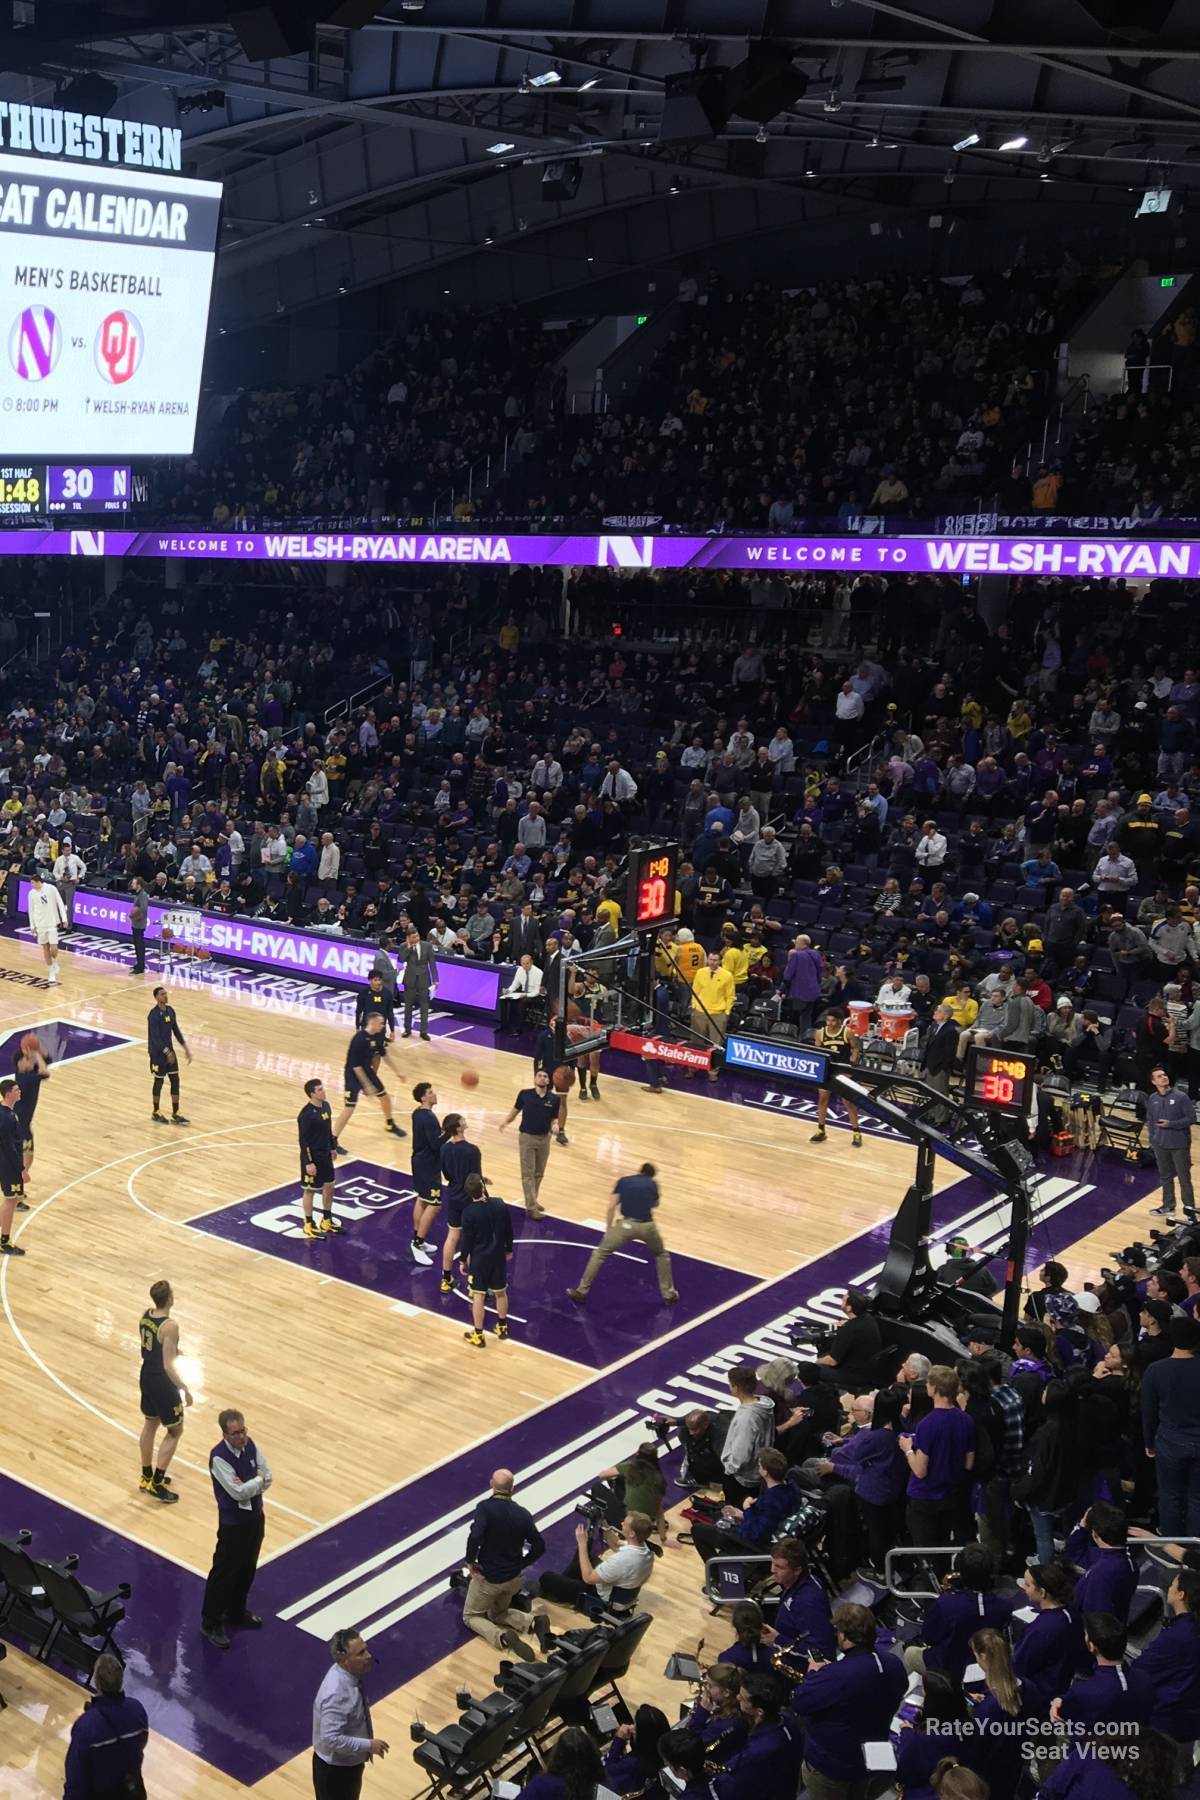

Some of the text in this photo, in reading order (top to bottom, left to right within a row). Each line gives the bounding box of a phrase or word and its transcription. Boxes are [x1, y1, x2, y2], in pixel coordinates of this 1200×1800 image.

[45, 188, 189, 241] CALENDAR
[14, 265, 162, 297] MEN'S BASKETBALL
[16, 398, 58, 413] 8:00 PM
[93, 400, 189, 415] WELSH-RYAN ARENA
[1, 468, 32, 478] 1ST HALF
[62, 468, 94, 499] 30
[113, 470, 126, 496] N
[158, 536, 512, 562] WELCOME TO WELSH-RYAN ARENA
[746, 543, 1190, 575] WELCOME TO WELSH-RYAN
[637, 879, 666, 920] 30
[164, 918, 318, 967] WELSH-RYAN
[732, 1042, 820, 1075] WINTRUST
[992, 1058, 1026, 1080] 1:48
[984, 1075, 1014, 1102] 30
[723, 1571, 740, 1584] 113
